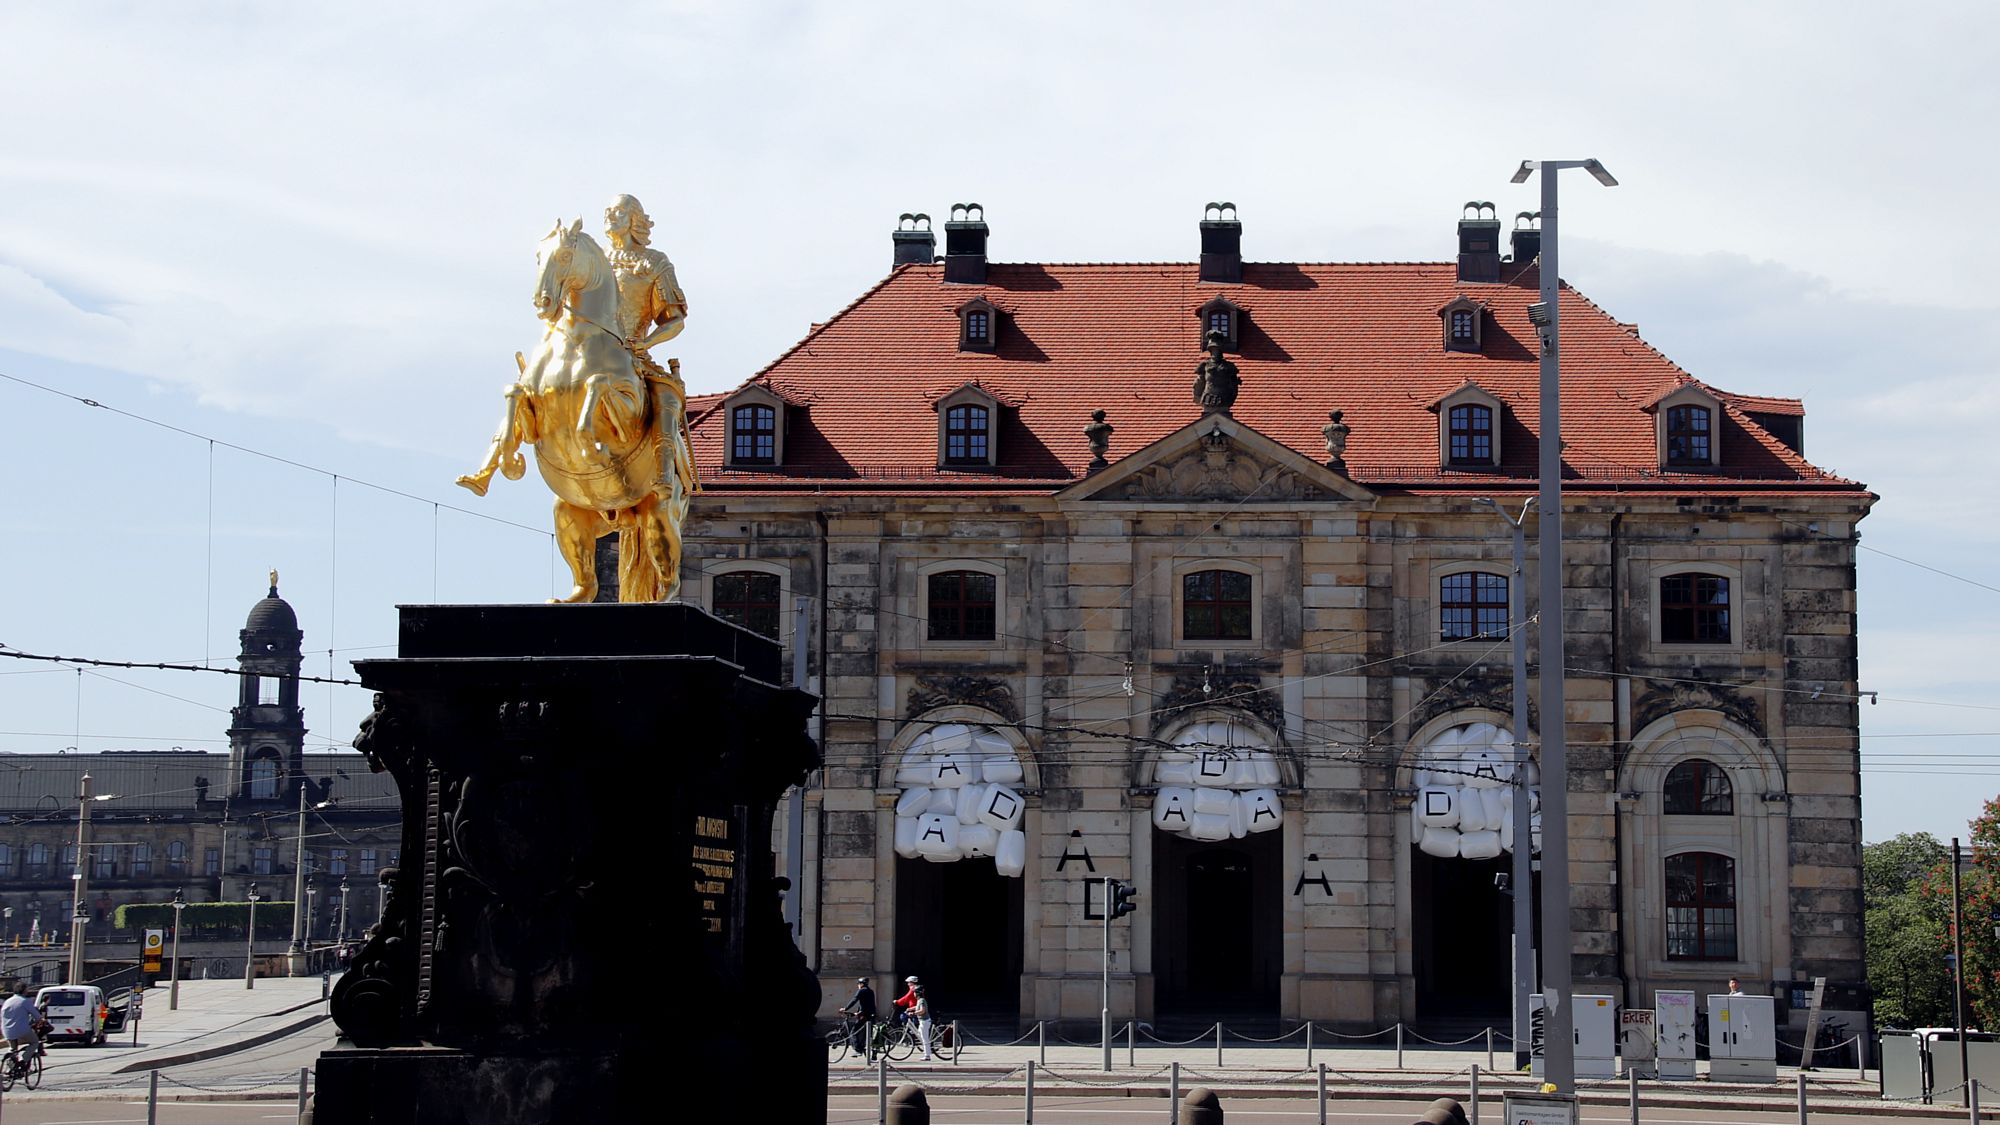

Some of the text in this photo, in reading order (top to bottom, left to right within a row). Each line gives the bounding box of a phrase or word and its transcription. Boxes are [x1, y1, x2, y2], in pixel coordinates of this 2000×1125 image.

[1163, 796, 1186, 822] A
[1253, 796, 1276, 824] A
[1426, 791, 1451, 816] D
[922, 818, 945, 842] A
[1056, 829, 1096, 872] A
[1293, 853, 1333, 896] A
